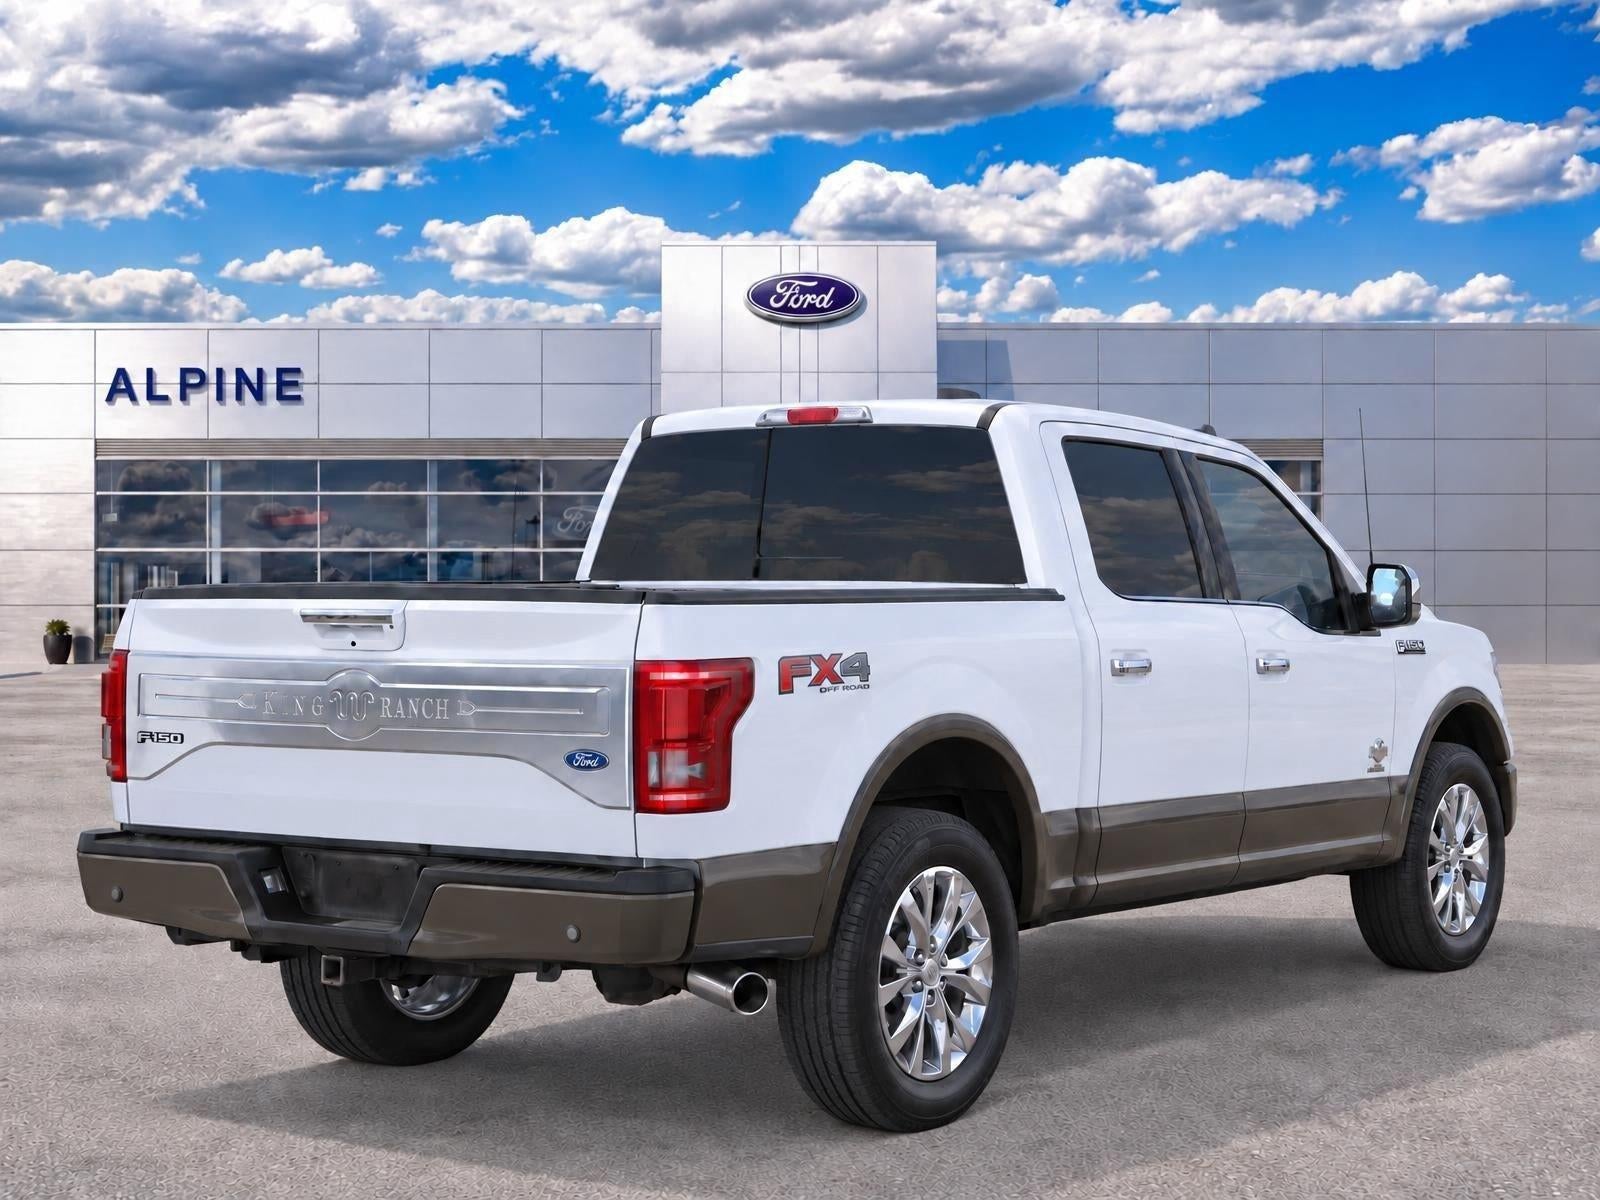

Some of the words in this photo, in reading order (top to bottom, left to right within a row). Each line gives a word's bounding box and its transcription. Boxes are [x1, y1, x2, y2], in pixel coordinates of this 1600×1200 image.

[769, 279, 835, 309] Ford
[105, 367, 303, 402] ALPINE
[557, 505, 598, 533] For
[778, 652, 870, 695] FX4
[819, 686, 840, 694] OFF
[842, 683, 870, 692] ROAD
[262, 690, 324, 717] KING
[379, 696, 449, 720] RANCH
[573, 752, 599, 767] Ford
